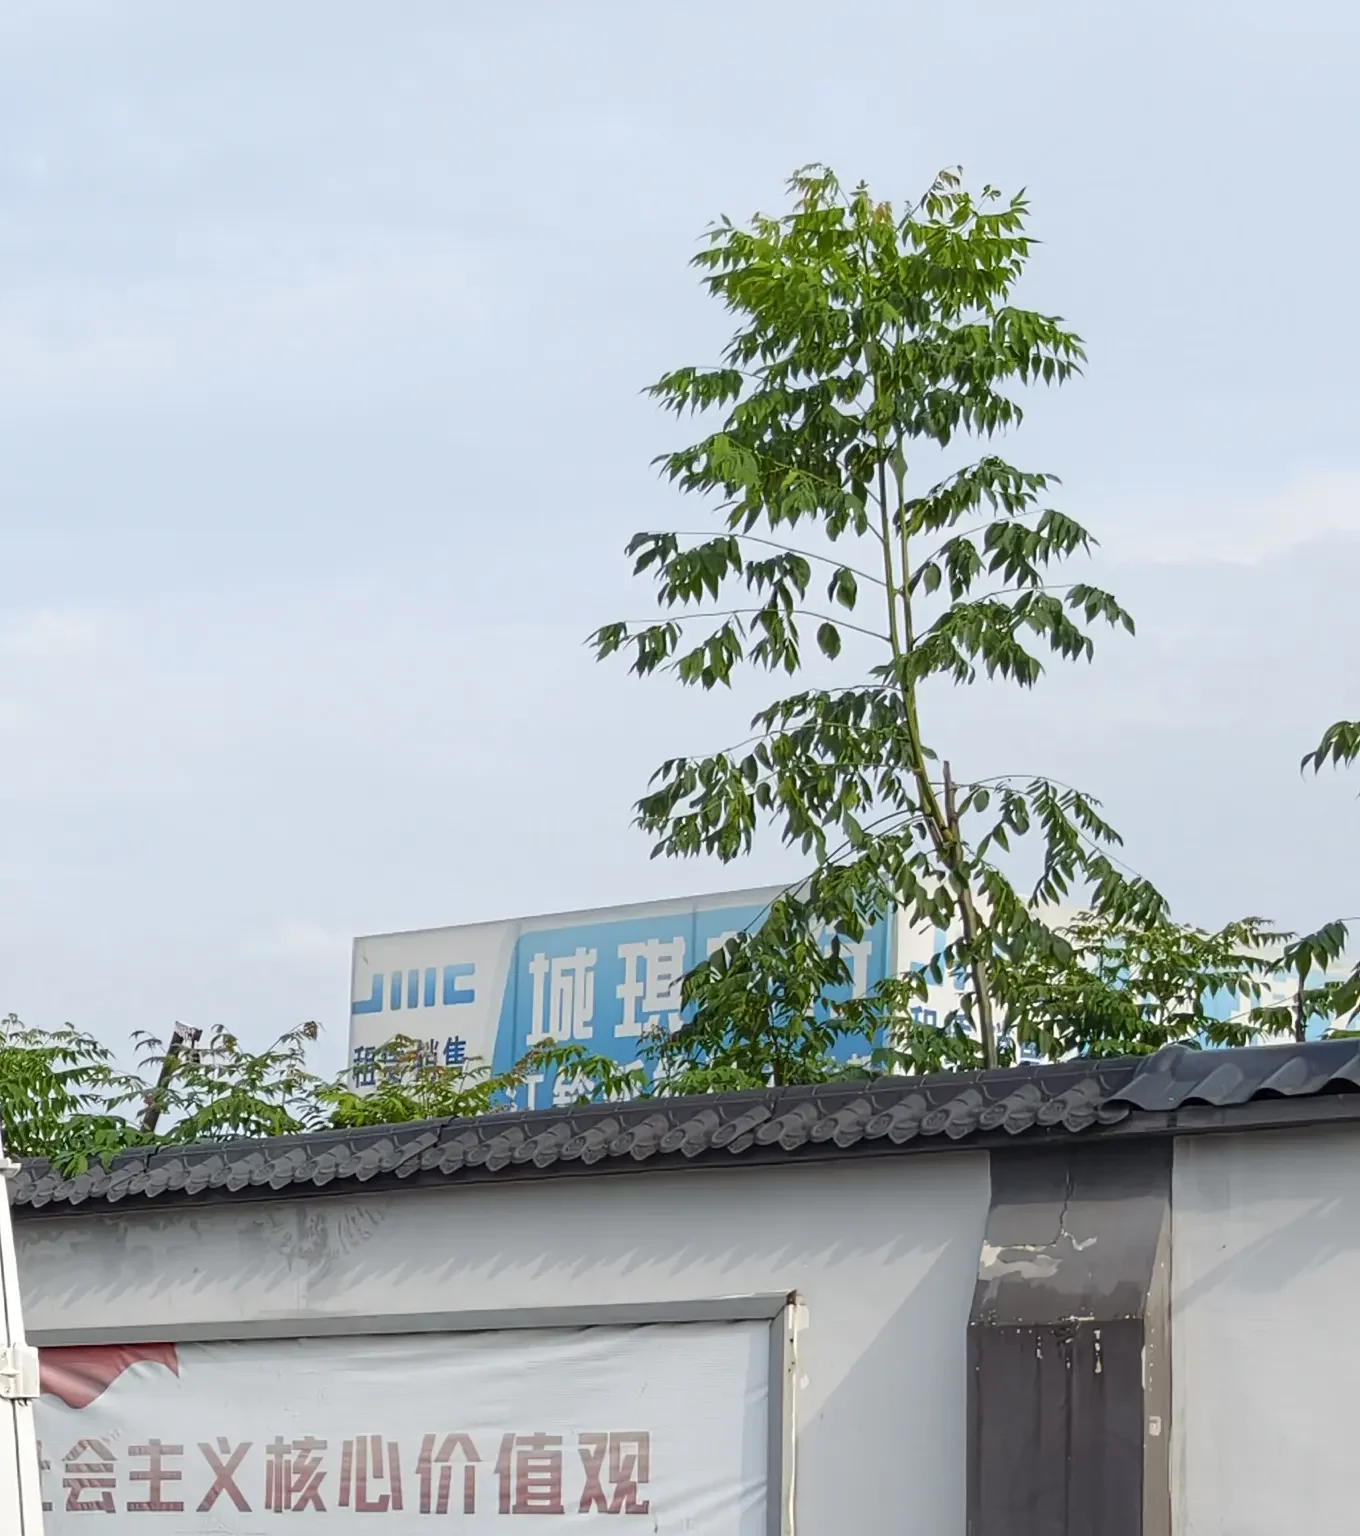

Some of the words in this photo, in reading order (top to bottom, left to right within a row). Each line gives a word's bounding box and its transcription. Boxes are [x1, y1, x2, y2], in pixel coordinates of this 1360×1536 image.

[37, 1432, 650, 1515] 会主义核心价值观
